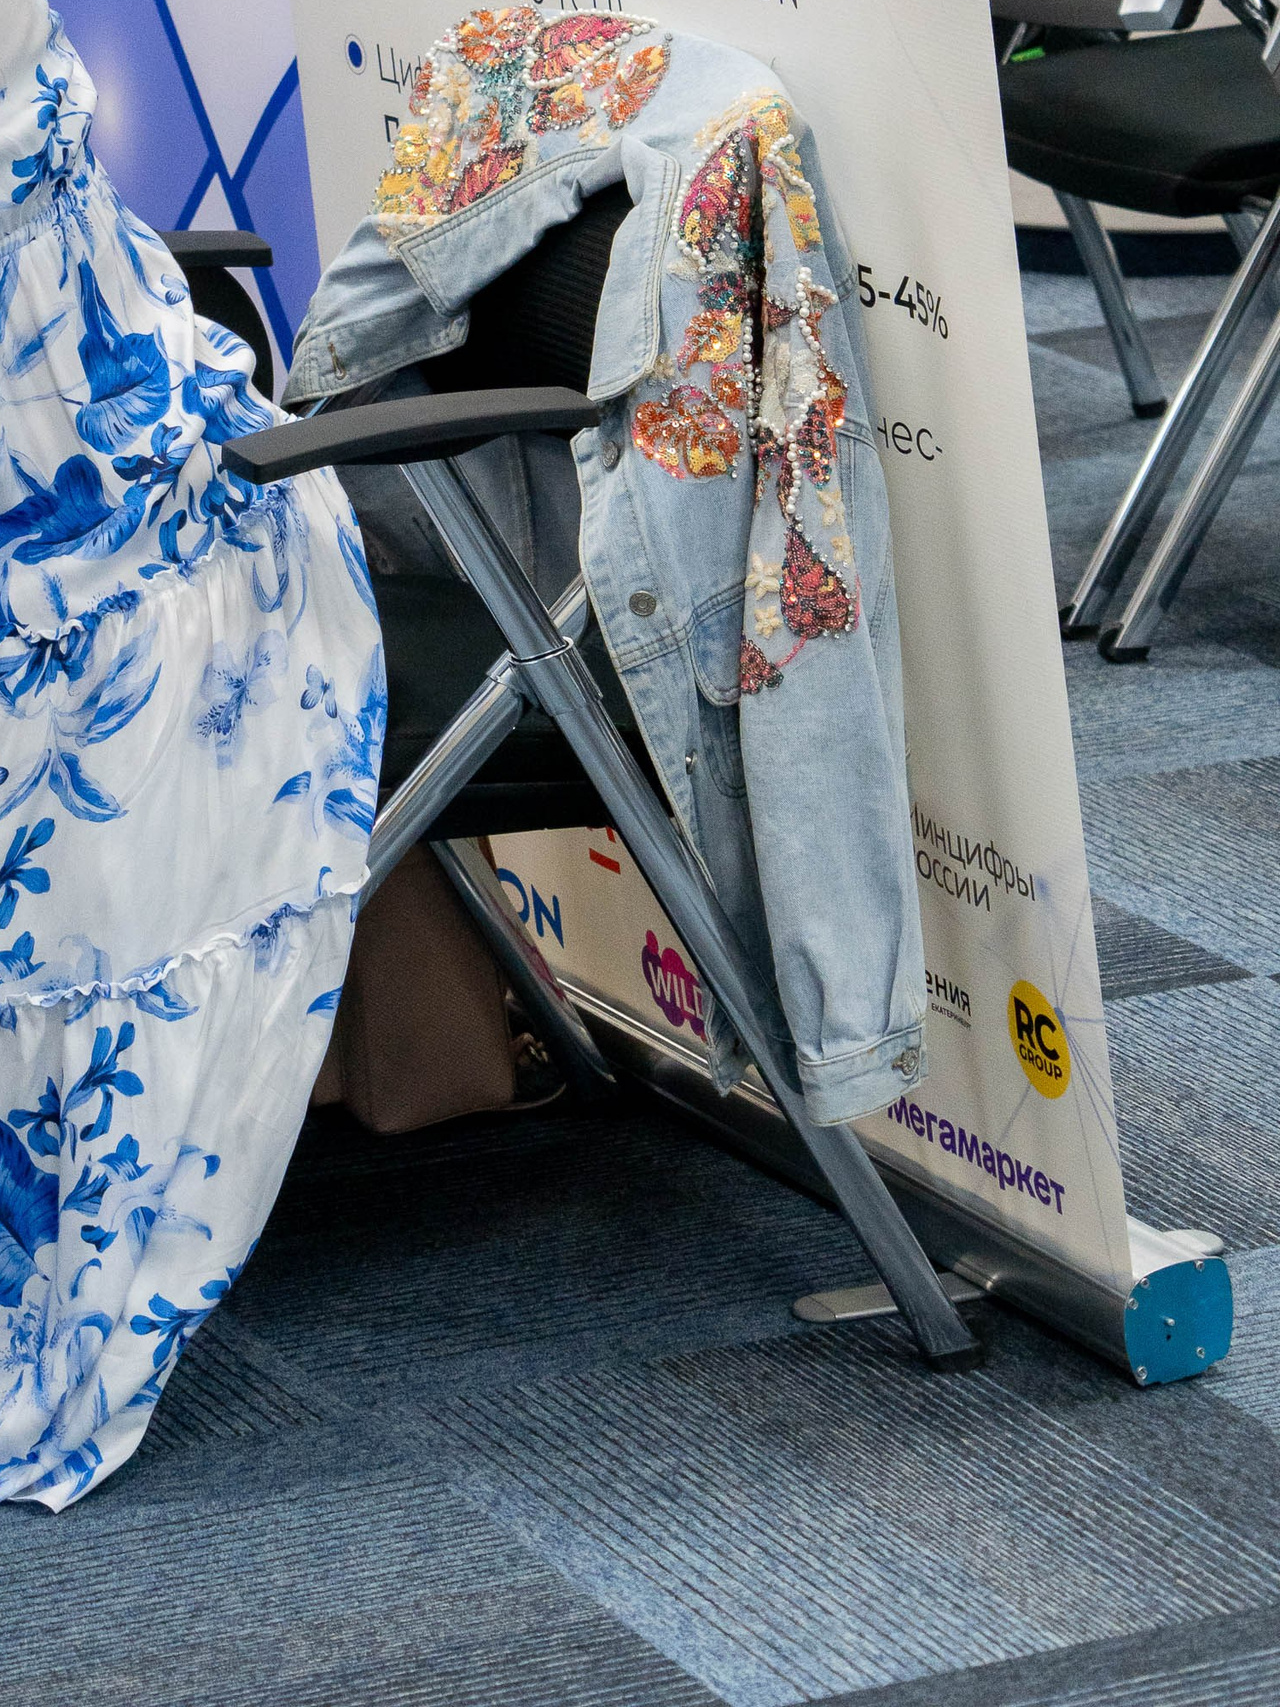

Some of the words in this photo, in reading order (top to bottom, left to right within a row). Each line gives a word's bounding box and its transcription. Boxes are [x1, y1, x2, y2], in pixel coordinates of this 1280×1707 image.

[857, 263, 949, 340] 5-45%
[914, 847, 991, 913] оссии
[1013, 995, 1060, 1061] RC
[1018, 1043, 1063, 1081] GROUP
